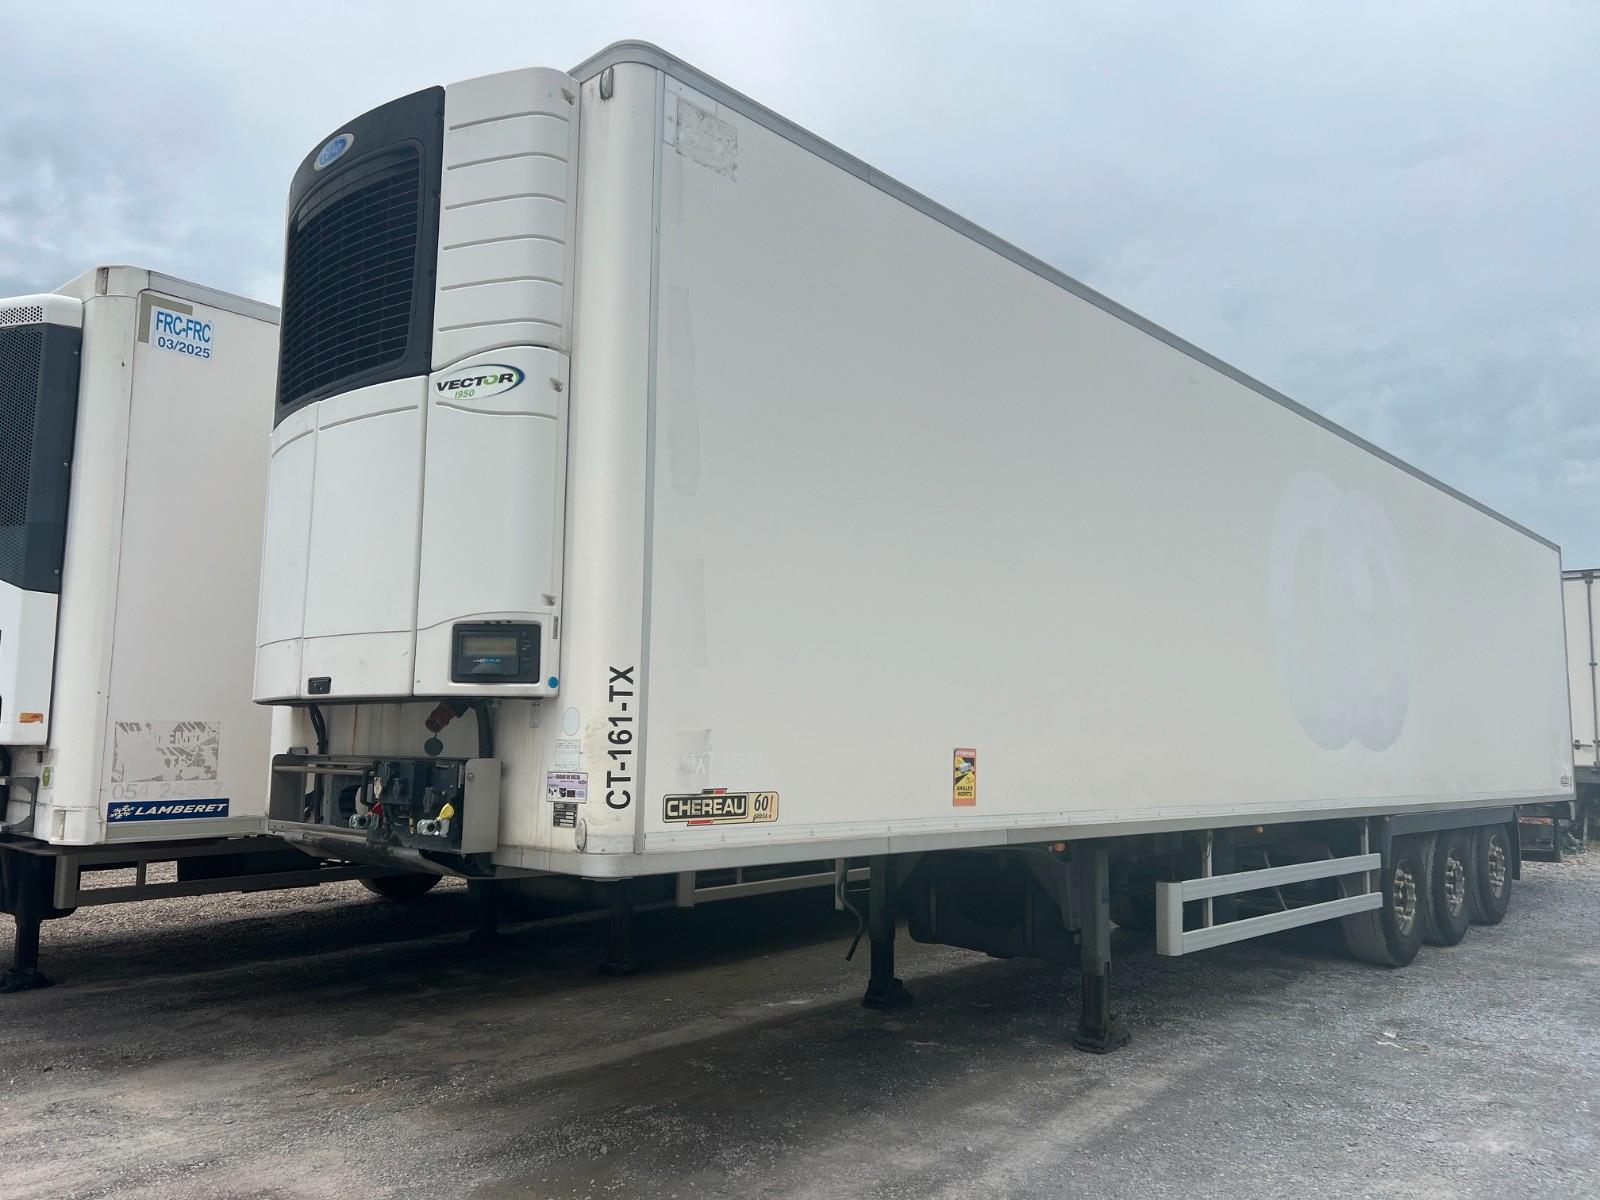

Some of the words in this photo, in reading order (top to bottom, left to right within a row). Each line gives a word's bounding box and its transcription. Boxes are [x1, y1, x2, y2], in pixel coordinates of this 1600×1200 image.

[156, 311, 211, 343] FRC-FRC
[158, 336, 210, 359] 03/2025
[436, 373, 514, 392] VECTOR
[454, 389, 475, 400] 1950
[605, 666, 635, 810] CT-161-TX
[134, 803, 228, 816] LAMBERET
[667, 798, 745, 817] CHEREAU
